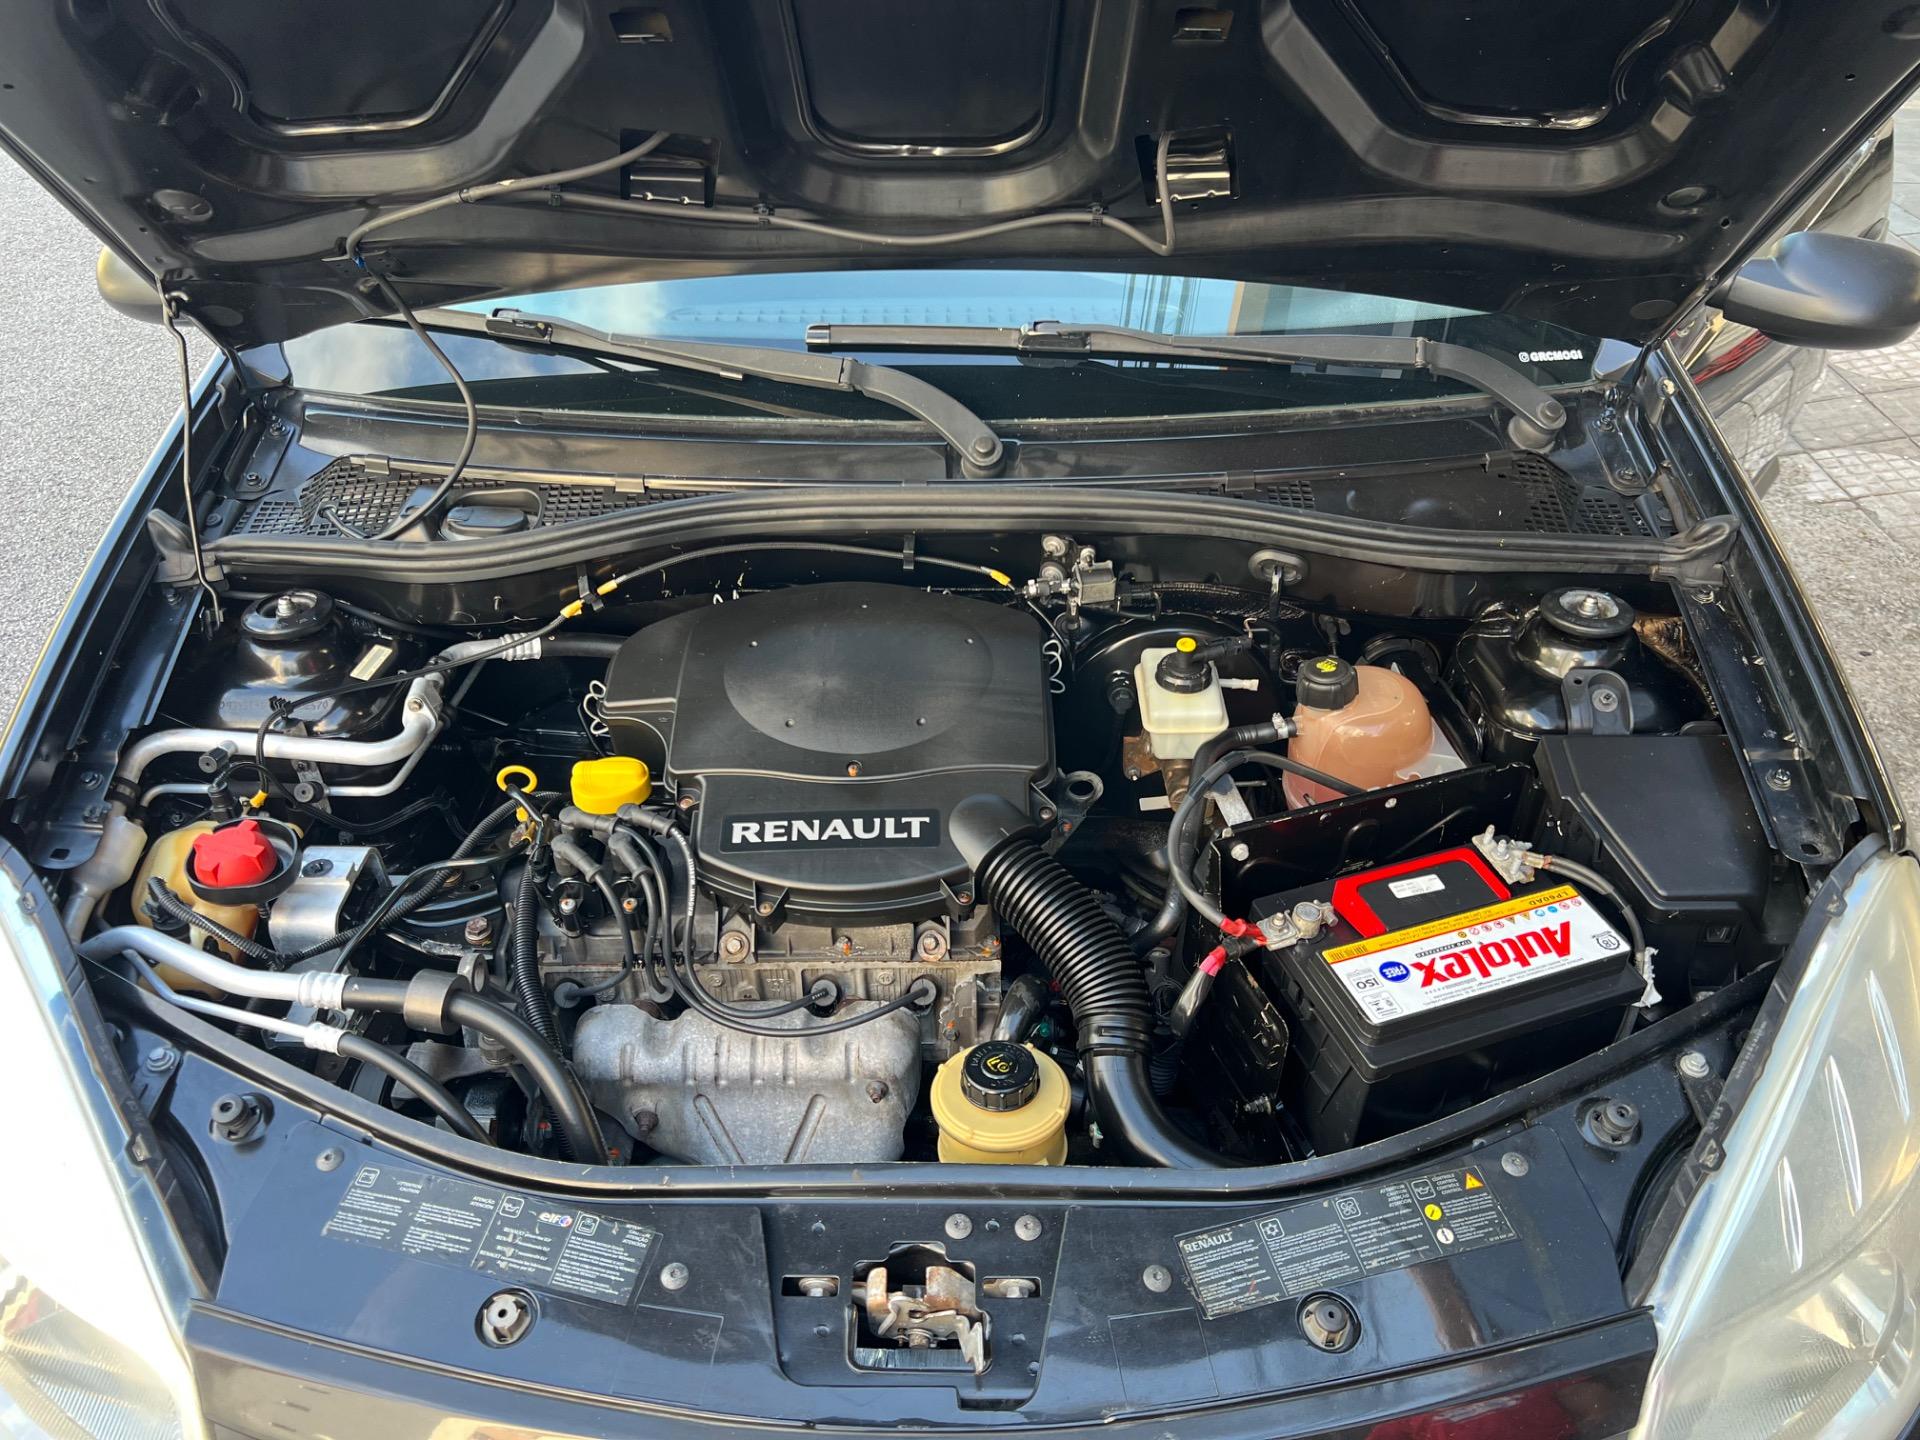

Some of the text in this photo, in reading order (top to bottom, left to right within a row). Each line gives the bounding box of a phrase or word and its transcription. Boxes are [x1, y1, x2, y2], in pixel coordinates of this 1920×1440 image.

[731, 817, 930, 844] RENAULT
[1382, 964, 1408, 979] FREE
[1355, 977, 1380, 990] ISO
[539, 1211, 561, 1224] elf
[1183, 1231, 1233, 1254] RENAULT
